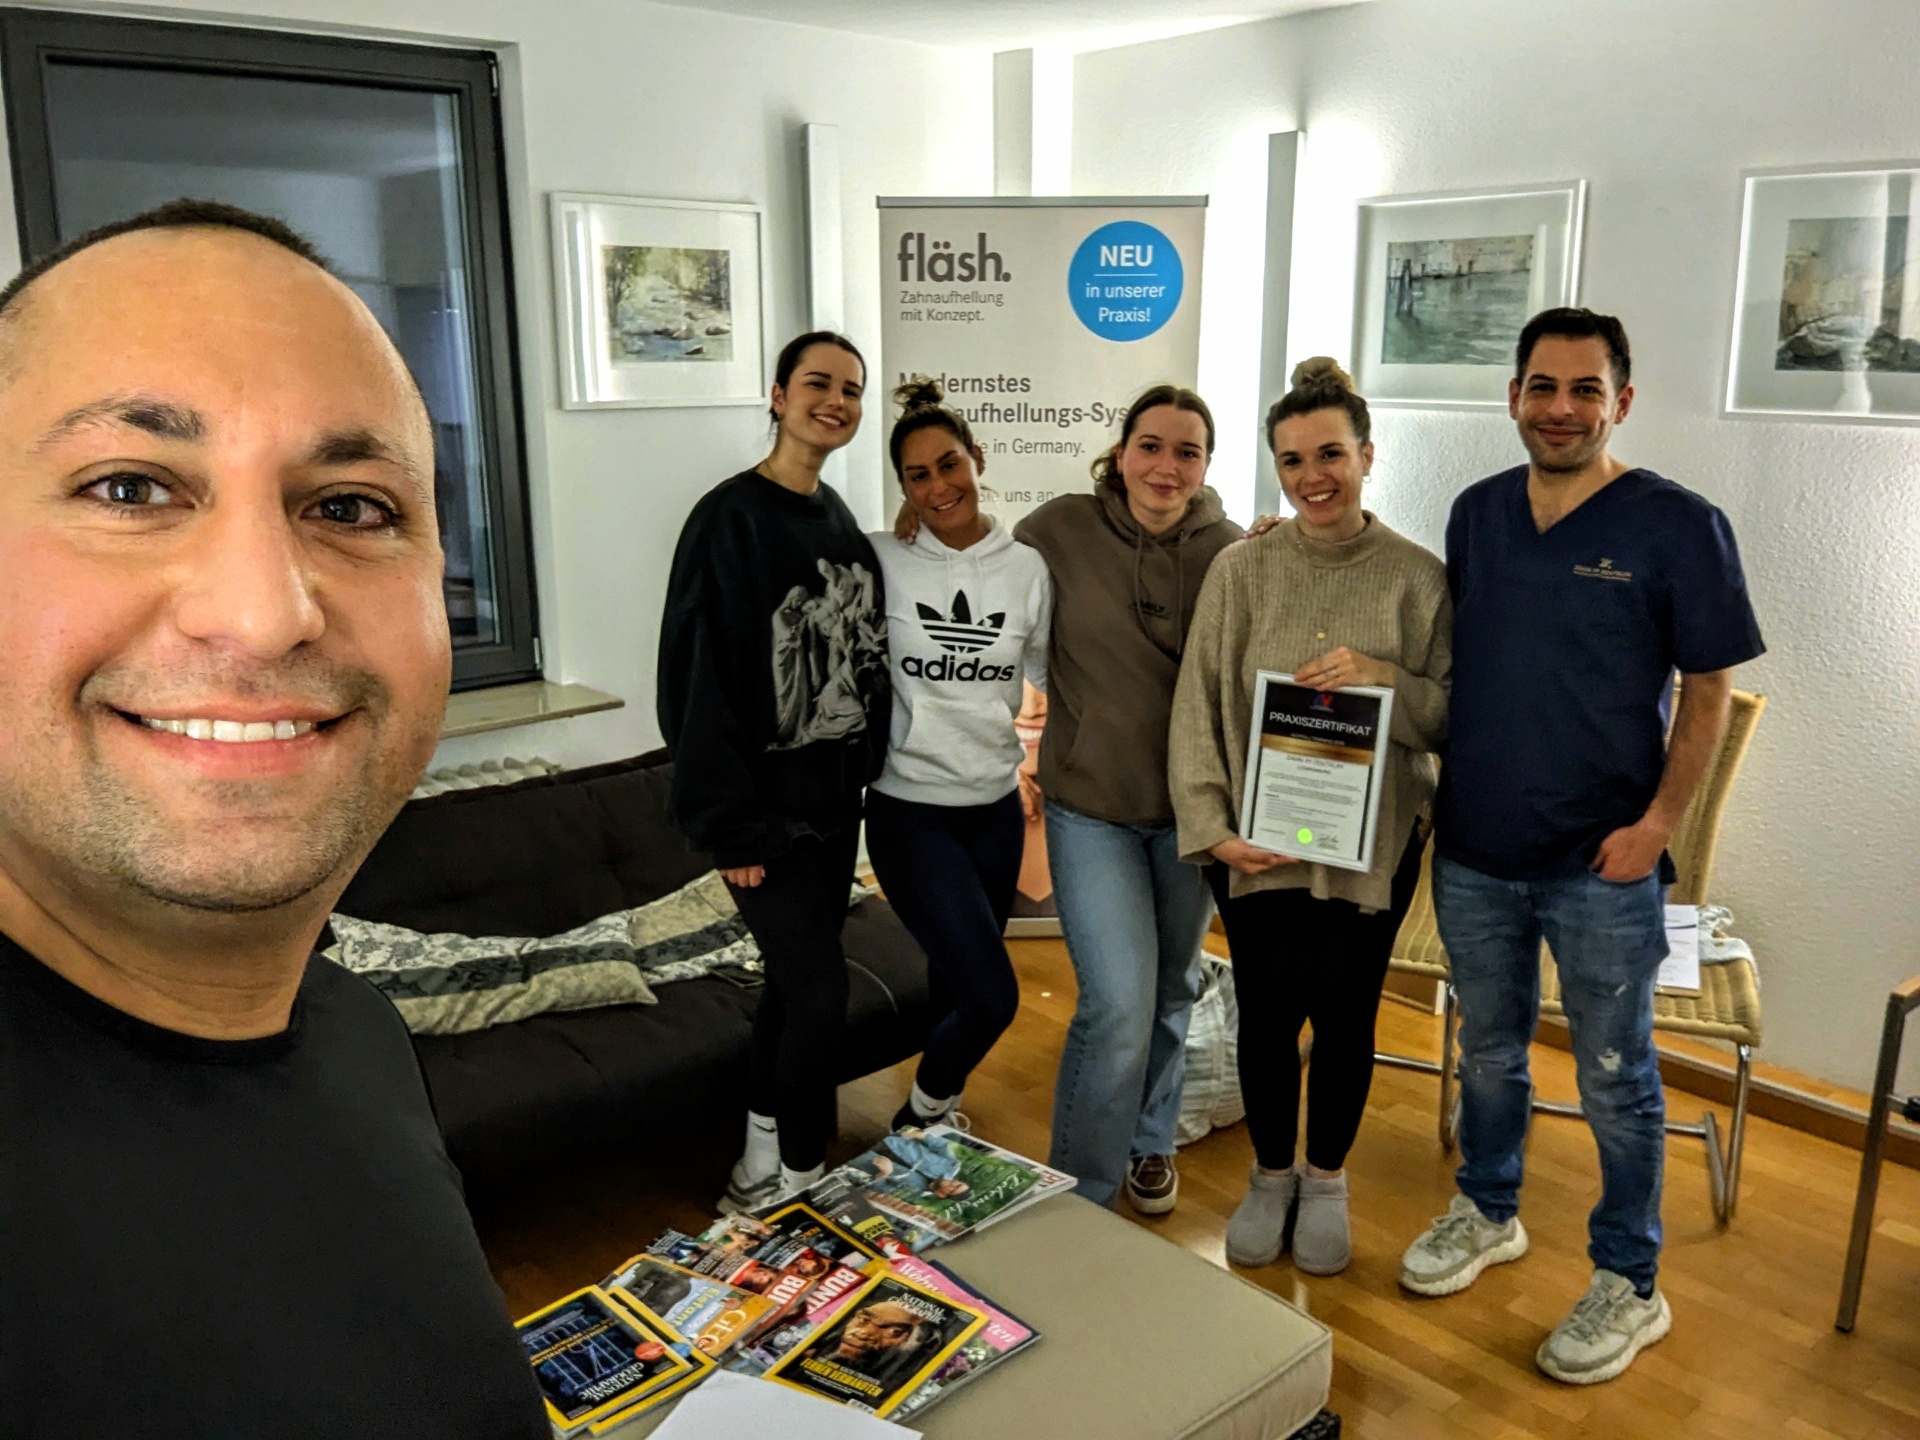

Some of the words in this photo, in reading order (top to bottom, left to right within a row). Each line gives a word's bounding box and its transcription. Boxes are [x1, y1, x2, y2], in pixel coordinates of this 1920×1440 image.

[898, 232, 1012, 283] fläsh.
[1100, 245, 1154, 267] NEU
[900, 290, 1004, 307] Zahnaufhellung
[1086, 283, 1100, 298] in
[1105, 285, 1166, 298] unserer
[901, 308, 923, 322] mit
[927, 308, 985, 325] Konzept.
[1099, 307, 1151, 322] Praxis!
[900, 372, 1031, 393] Mdernstes
[955, 402, 1129, 429] aufhellungs-Sys
[993, 438, 1007, 454] in
[1012, 437, 1086, 458] Germany.
[1004, 490, 1032, 503] uns
[901, 654, 1015, 681] adidas
[1269, 711, 1372, 736] PRAXISZERTIFIKAT
[887, 1295, 948, 1325] GEOGRAPHIC
[900, 1291, 947, 1316] NATIONAL
[580, 1361, 645, 1400] GEOGRAPHIC
[593, 1372, 645, 1401] NATIONAL
